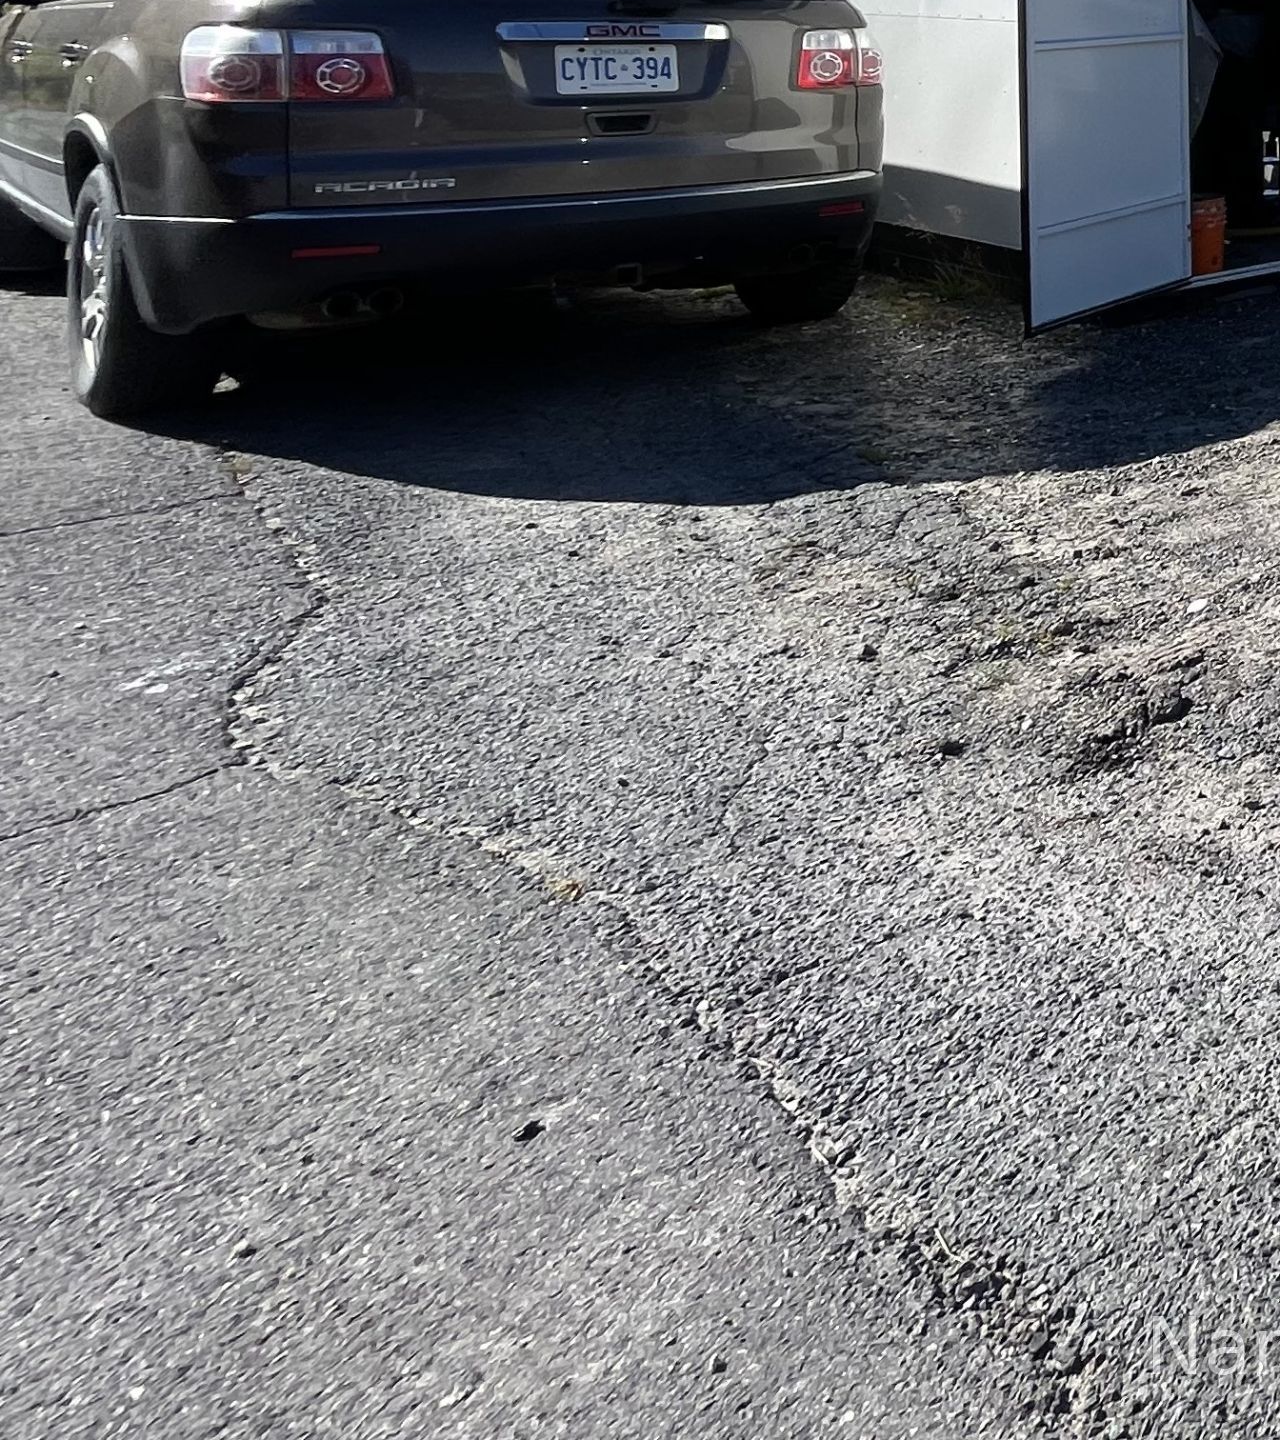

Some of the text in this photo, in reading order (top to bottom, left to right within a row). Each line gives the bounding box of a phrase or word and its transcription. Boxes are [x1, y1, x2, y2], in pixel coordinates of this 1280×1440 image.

[584, 25, 661, 37] GMC
[561, 56, 672, 81] CYTC 394
[314, 177, 456, 193] ACADIA
